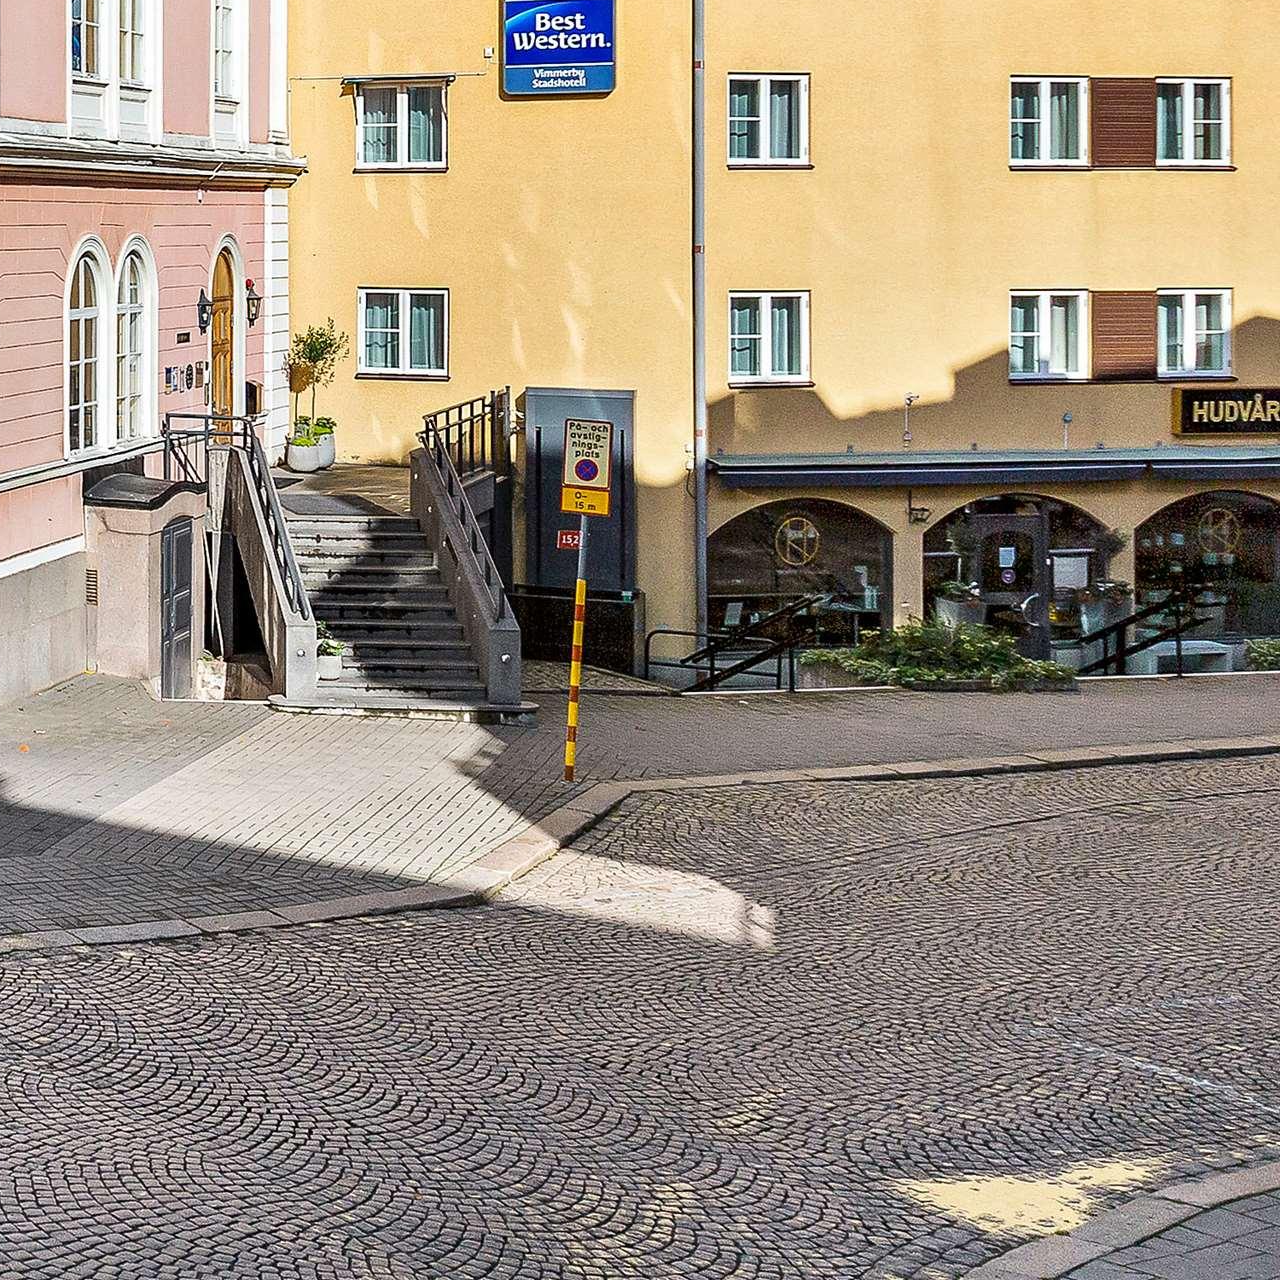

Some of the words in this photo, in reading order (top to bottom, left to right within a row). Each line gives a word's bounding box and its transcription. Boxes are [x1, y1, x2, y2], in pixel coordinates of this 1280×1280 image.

[535, 12, 585, 32] Best
[533, 67, 585, 79] Vimmerby
[532, 77, 587, 89] Stadshotell
[1192, 393, 1280, 423] HUDVÅR
[569, 422, 587, 431] På-
[570, 432, 607, 442] avstig-
[572, 440, 604, 450] nings-
[575, 450, 600, 458] plats
[575, 501, 585, 509] 15
